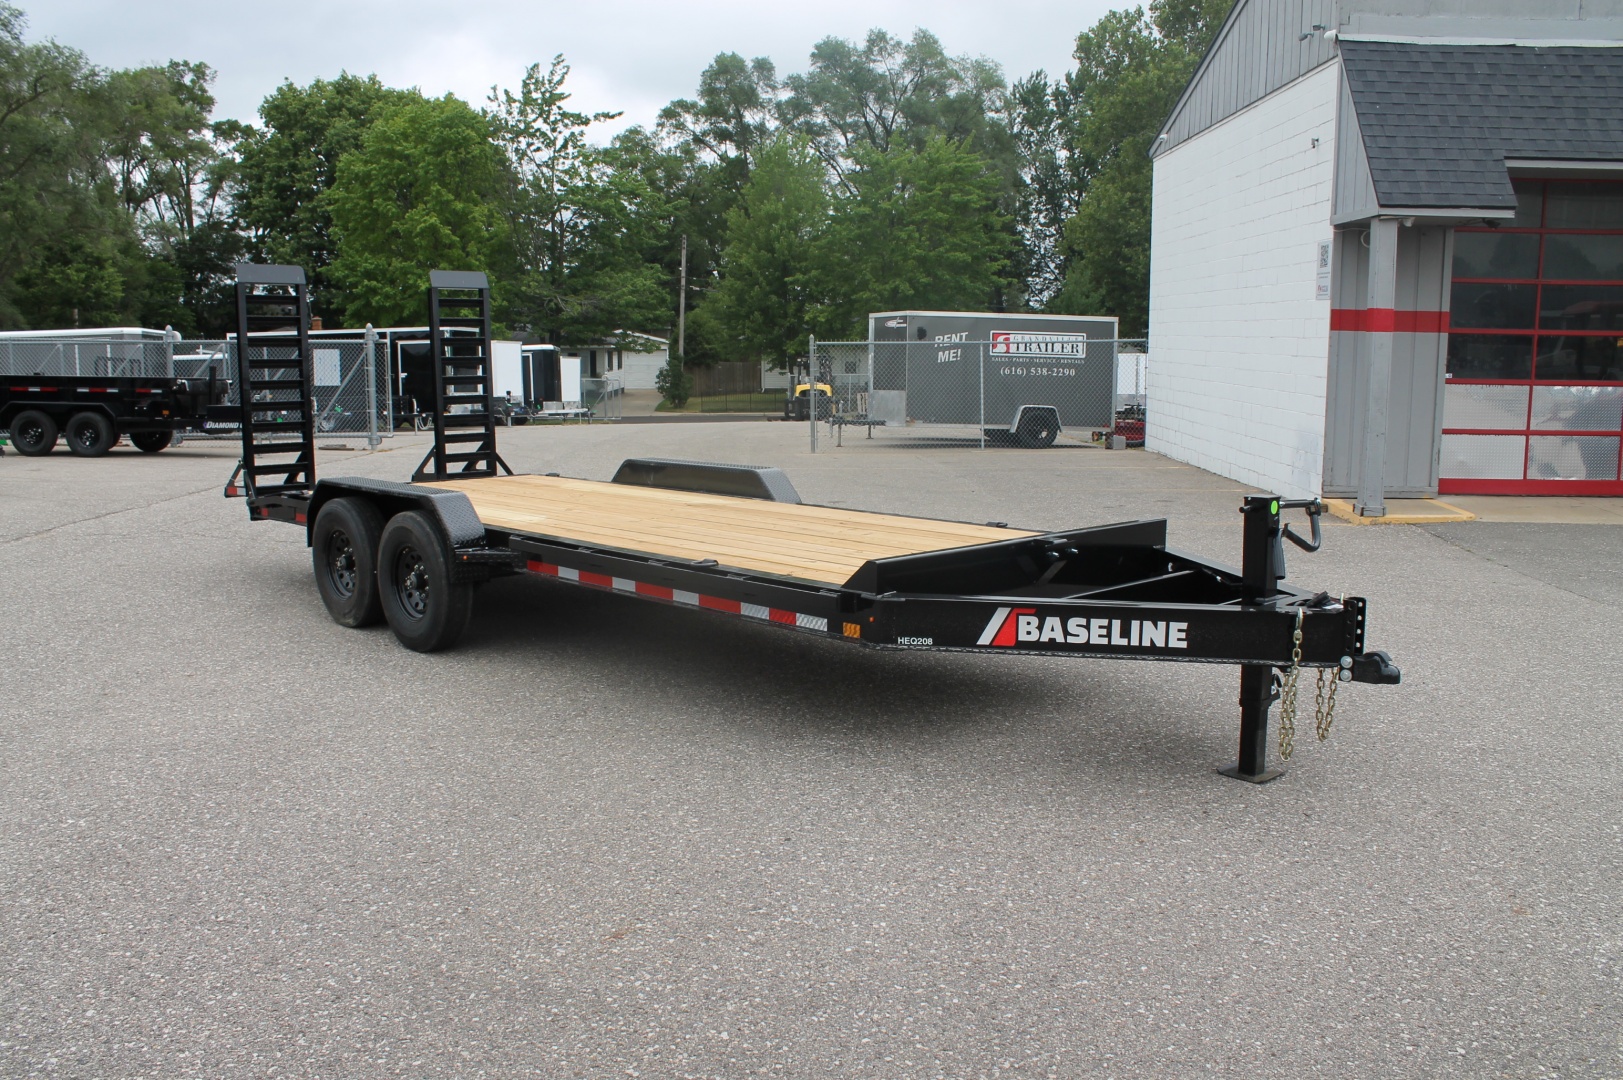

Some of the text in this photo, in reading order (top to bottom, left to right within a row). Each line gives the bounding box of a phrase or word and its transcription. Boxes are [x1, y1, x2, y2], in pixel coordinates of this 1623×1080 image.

[934, 331, 968, 347] RENT
[1013, 341, 1080, 353] TRAILER
[937, 348, 961, 362] ME!
[1000, 366, 1076, 377] (616) 538-2290
[1017, 615, 1188, 649] BASELINE
[897, 636, 933, 645] HEQ208
